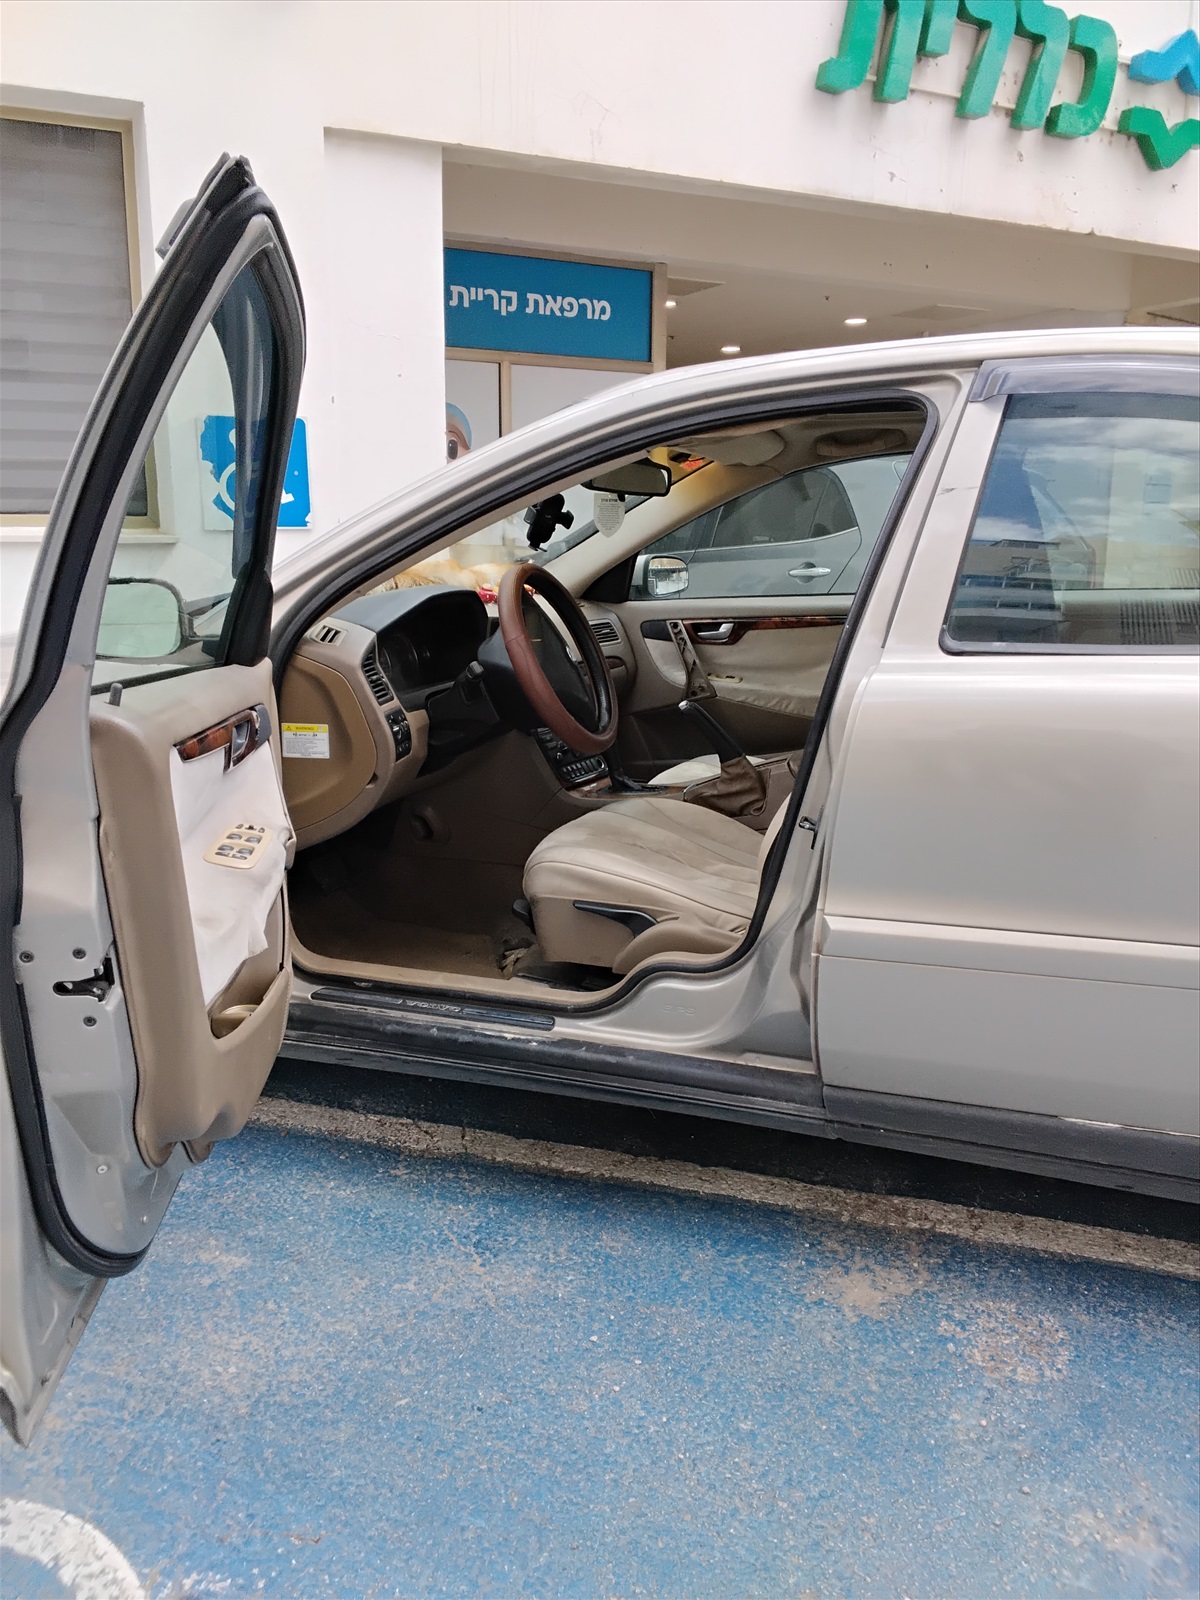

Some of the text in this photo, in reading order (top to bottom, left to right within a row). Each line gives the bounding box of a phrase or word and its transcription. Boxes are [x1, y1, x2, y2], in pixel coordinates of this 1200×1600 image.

[449, 285, 611, 321] מרפאת קריית
[405, 999, 462, 1012] VOLVO
